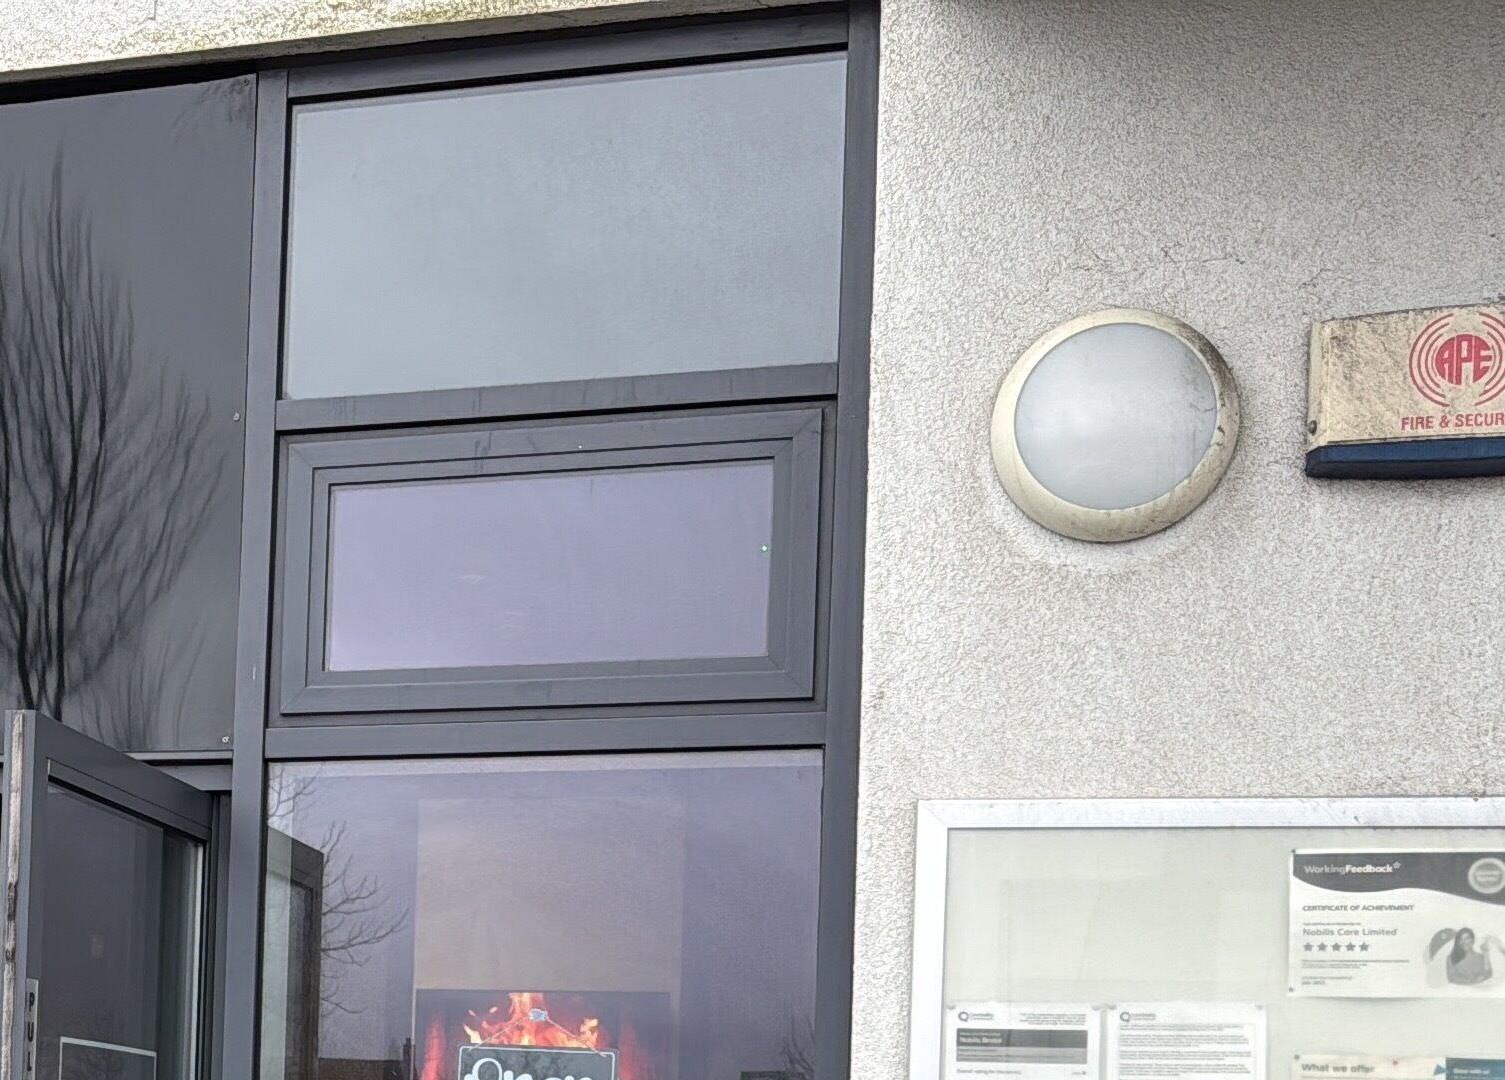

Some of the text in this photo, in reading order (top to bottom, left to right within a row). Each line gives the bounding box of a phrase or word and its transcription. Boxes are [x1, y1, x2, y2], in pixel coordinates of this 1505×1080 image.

[1435, 334, 1492, 385] APE
[1401, 416, 1434, 430] FIRE
[1439, 415, 1450, 428] &
[1362, 928, 1397, 936] Limited
